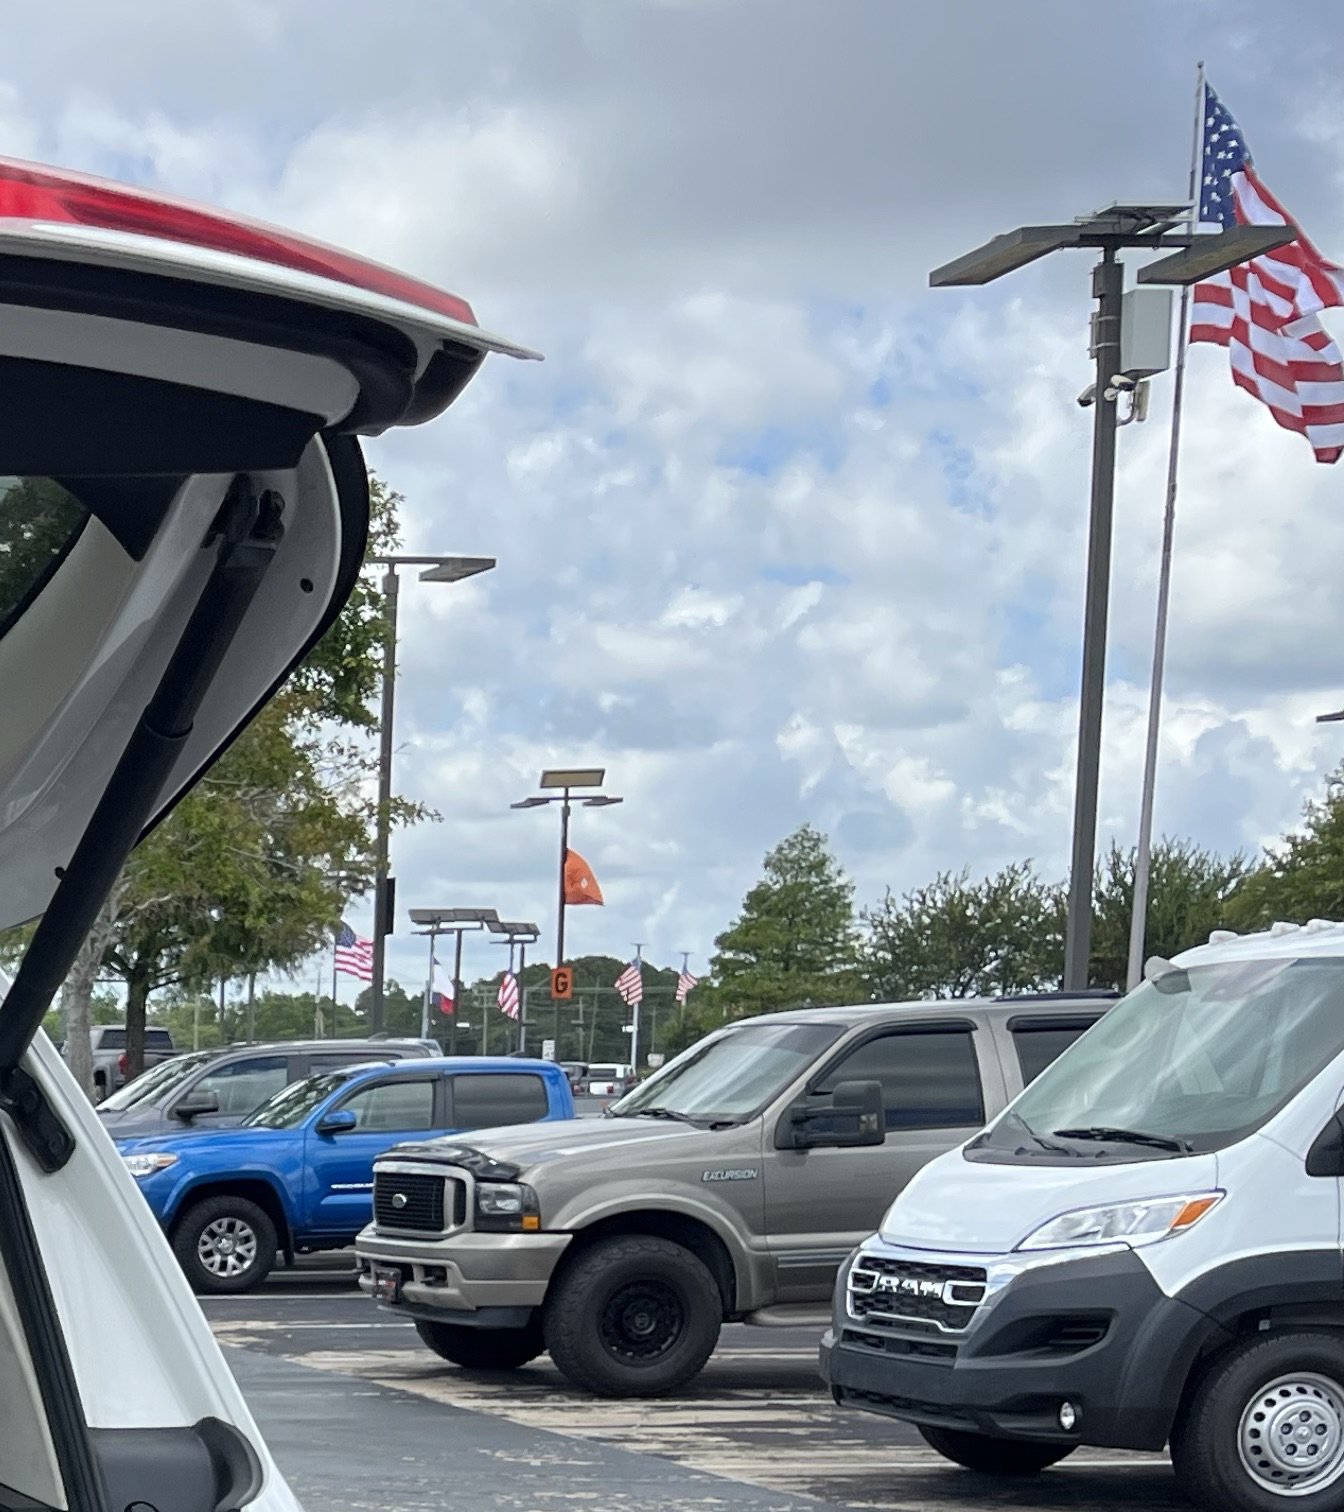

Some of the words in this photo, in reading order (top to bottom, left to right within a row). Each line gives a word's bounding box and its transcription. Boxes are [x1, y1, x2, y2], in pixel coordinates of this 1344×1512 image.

[555, 972, 568, 993] G
[702, 1169, 759, 1182] EXCURSION
[879, 1276, 944, 1299] RAM
